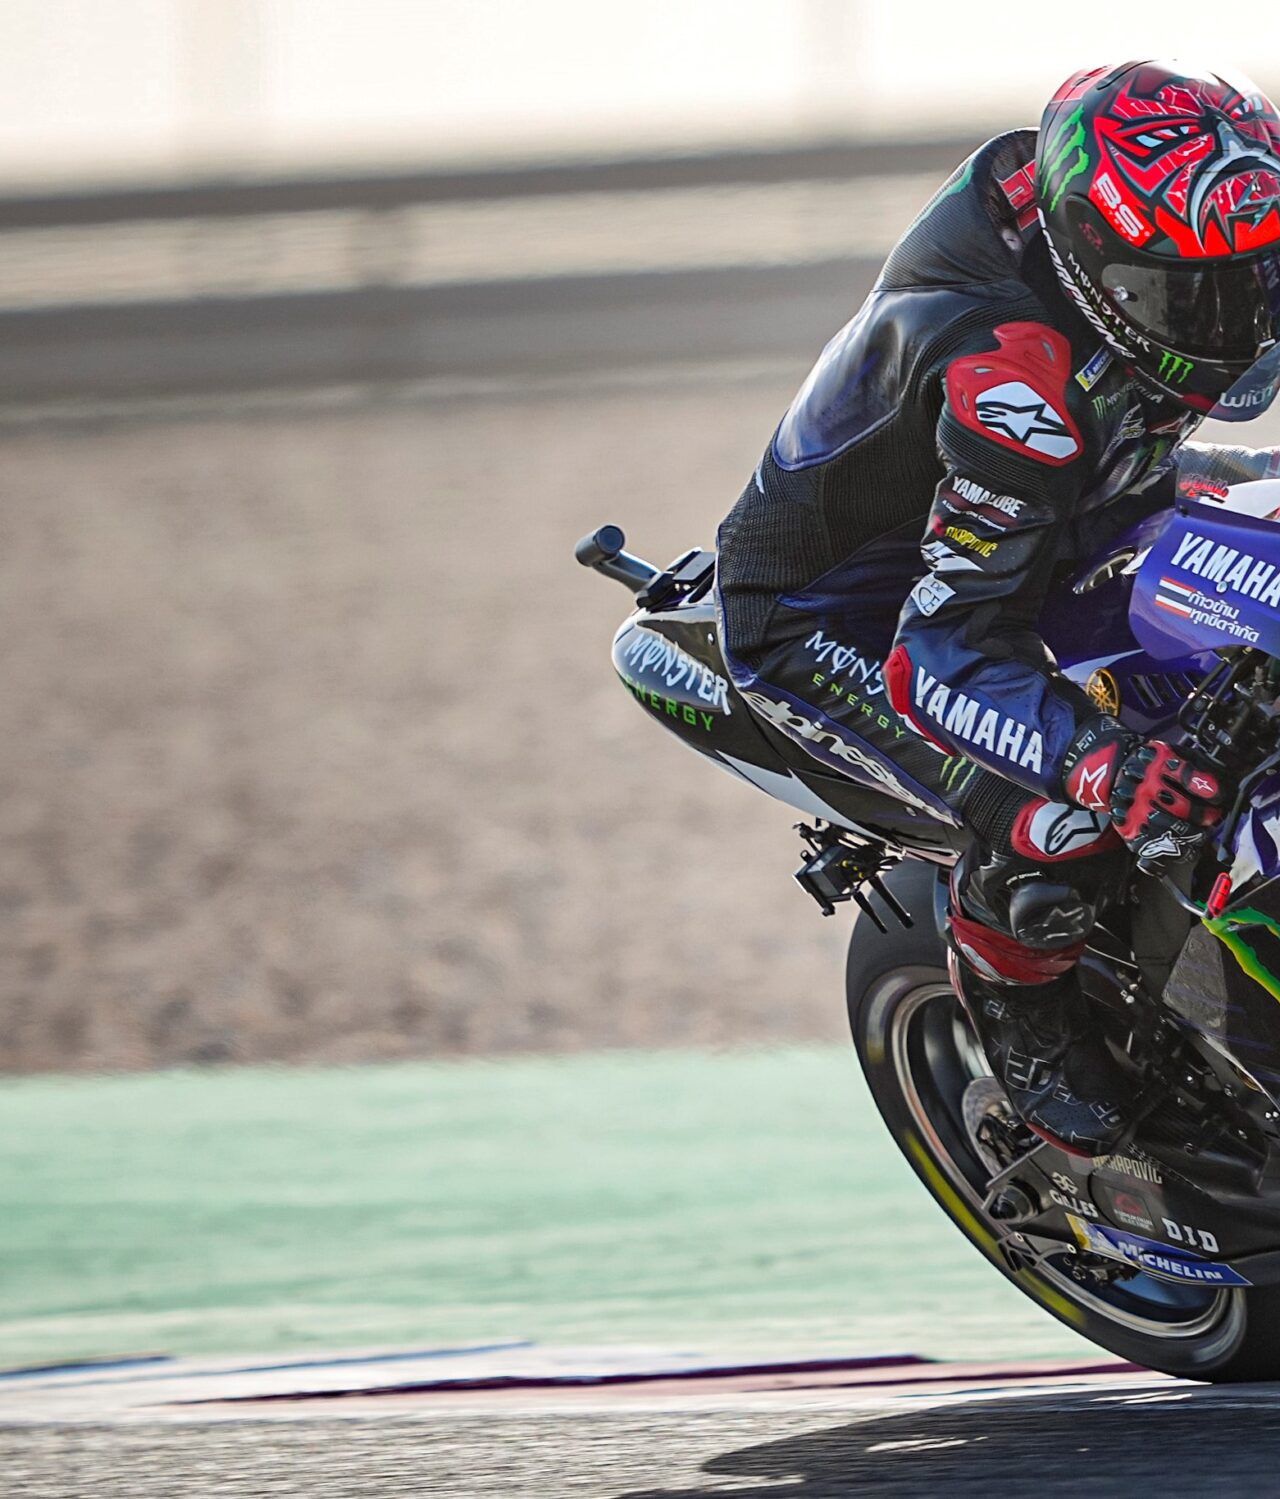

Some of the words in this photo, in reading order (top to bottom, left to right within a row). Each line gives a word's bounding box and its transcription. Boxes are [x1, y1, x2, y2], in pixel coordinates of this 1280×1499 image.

[1097, 173, 1145, 237] BS
[624, 631, 732, 716] MONSTER
[805, 630, 885, 696] MONS
[624, 674, 714, 732] ENERGY
[812, 672, 905, 740] ENERGY
[914, 666, 1043, 775] YAMAHA
[1049, 1189, 1099, 1218] GILLES
[1117, 1241, 1224, 1280] MICHELIN
